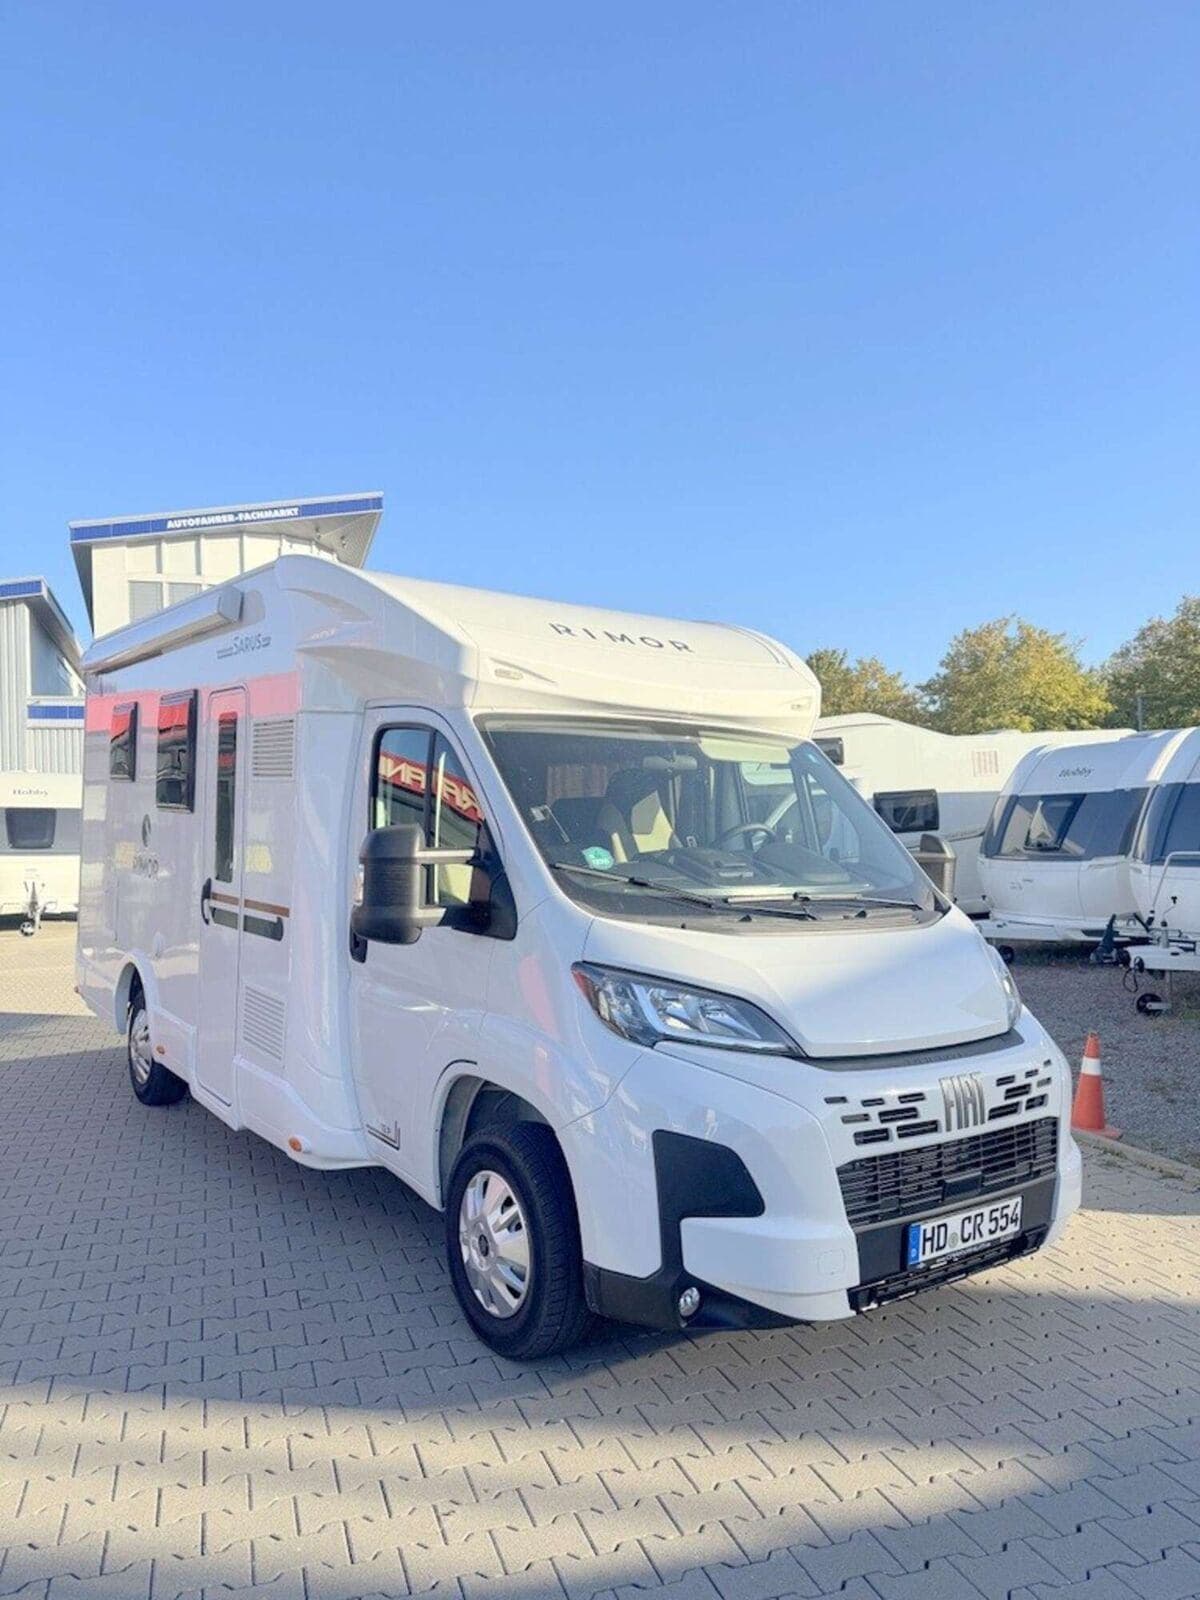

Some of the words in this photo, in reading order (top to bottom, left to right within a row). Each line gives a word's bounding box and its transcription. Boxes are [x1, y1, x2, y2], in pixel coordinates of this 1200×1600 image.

[166, 507, 299, 529] AUTOFAHRER-FACHMARKT
[549, 623, 694, 653] RIMOR
[1058, 766, 1094, 778] Hobby
[12, 787, 48, 798] Hobby
[938, 1072, 985, 1132] FIAT
[922, 1223, 948, 1256] HD
[960, 1212, 985, 1243] CR
[988, 1201, 1020, 1235] 554
